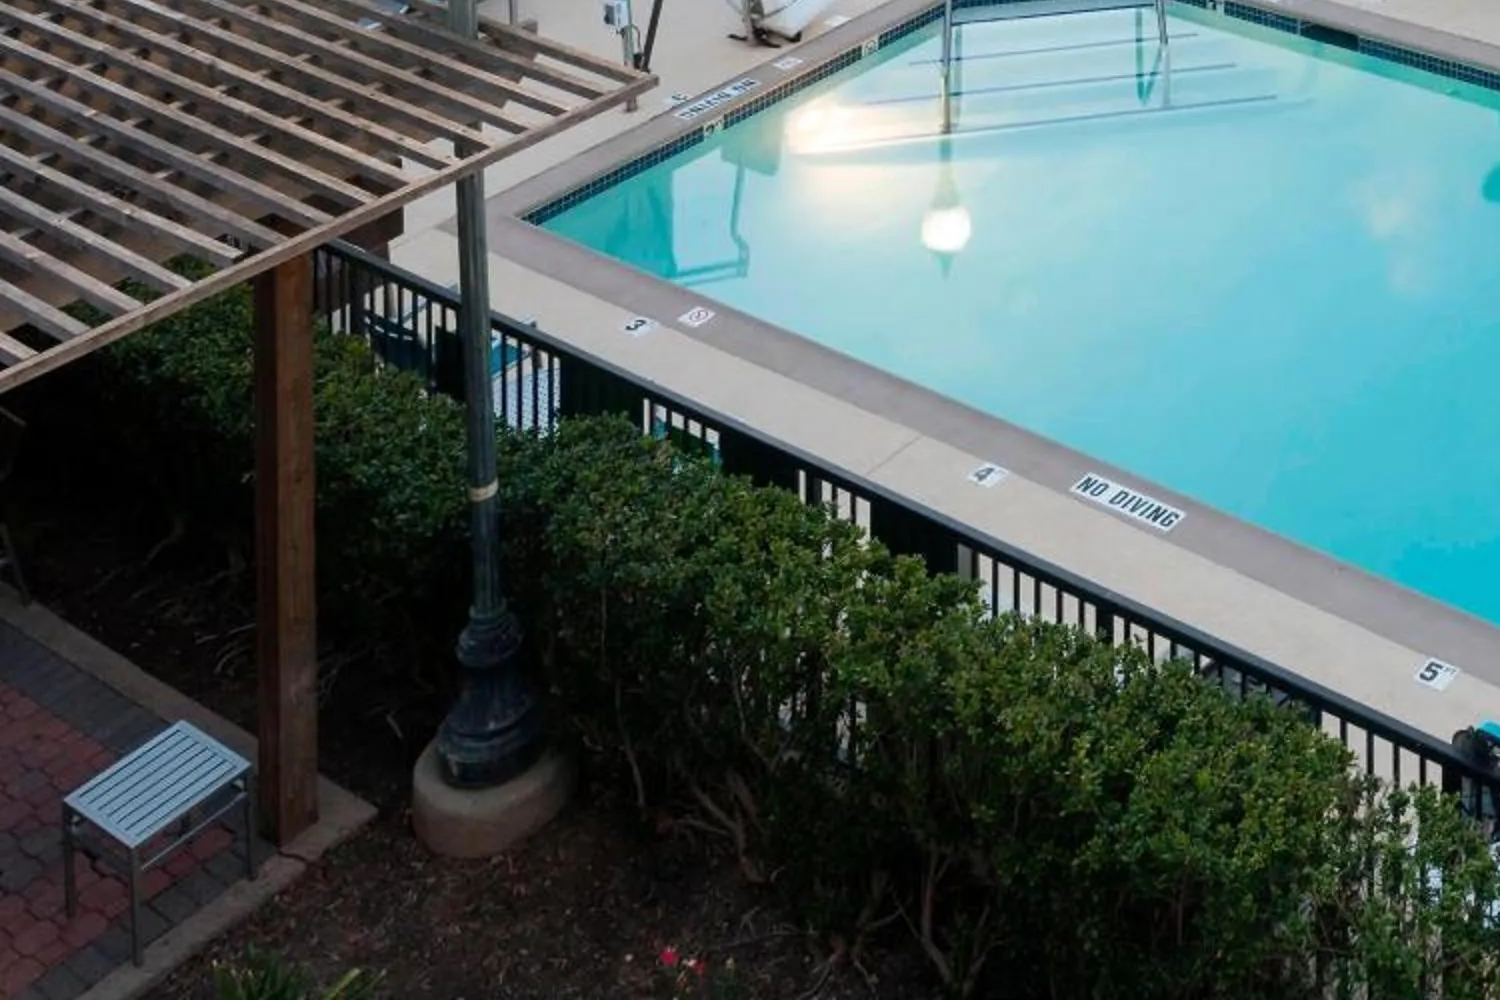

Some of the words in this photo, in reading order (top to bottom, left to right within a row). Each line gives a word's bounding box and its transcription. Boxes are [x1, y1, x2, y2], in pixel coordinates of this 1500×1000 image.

[624, 319, 647, 332] 3
[973, 467, 994, 482] 4
[1076, 476, 1109, 498] NO
[1109, 489, 1181, 529] DIVING
[1419, 661, 1443, 682] 5
